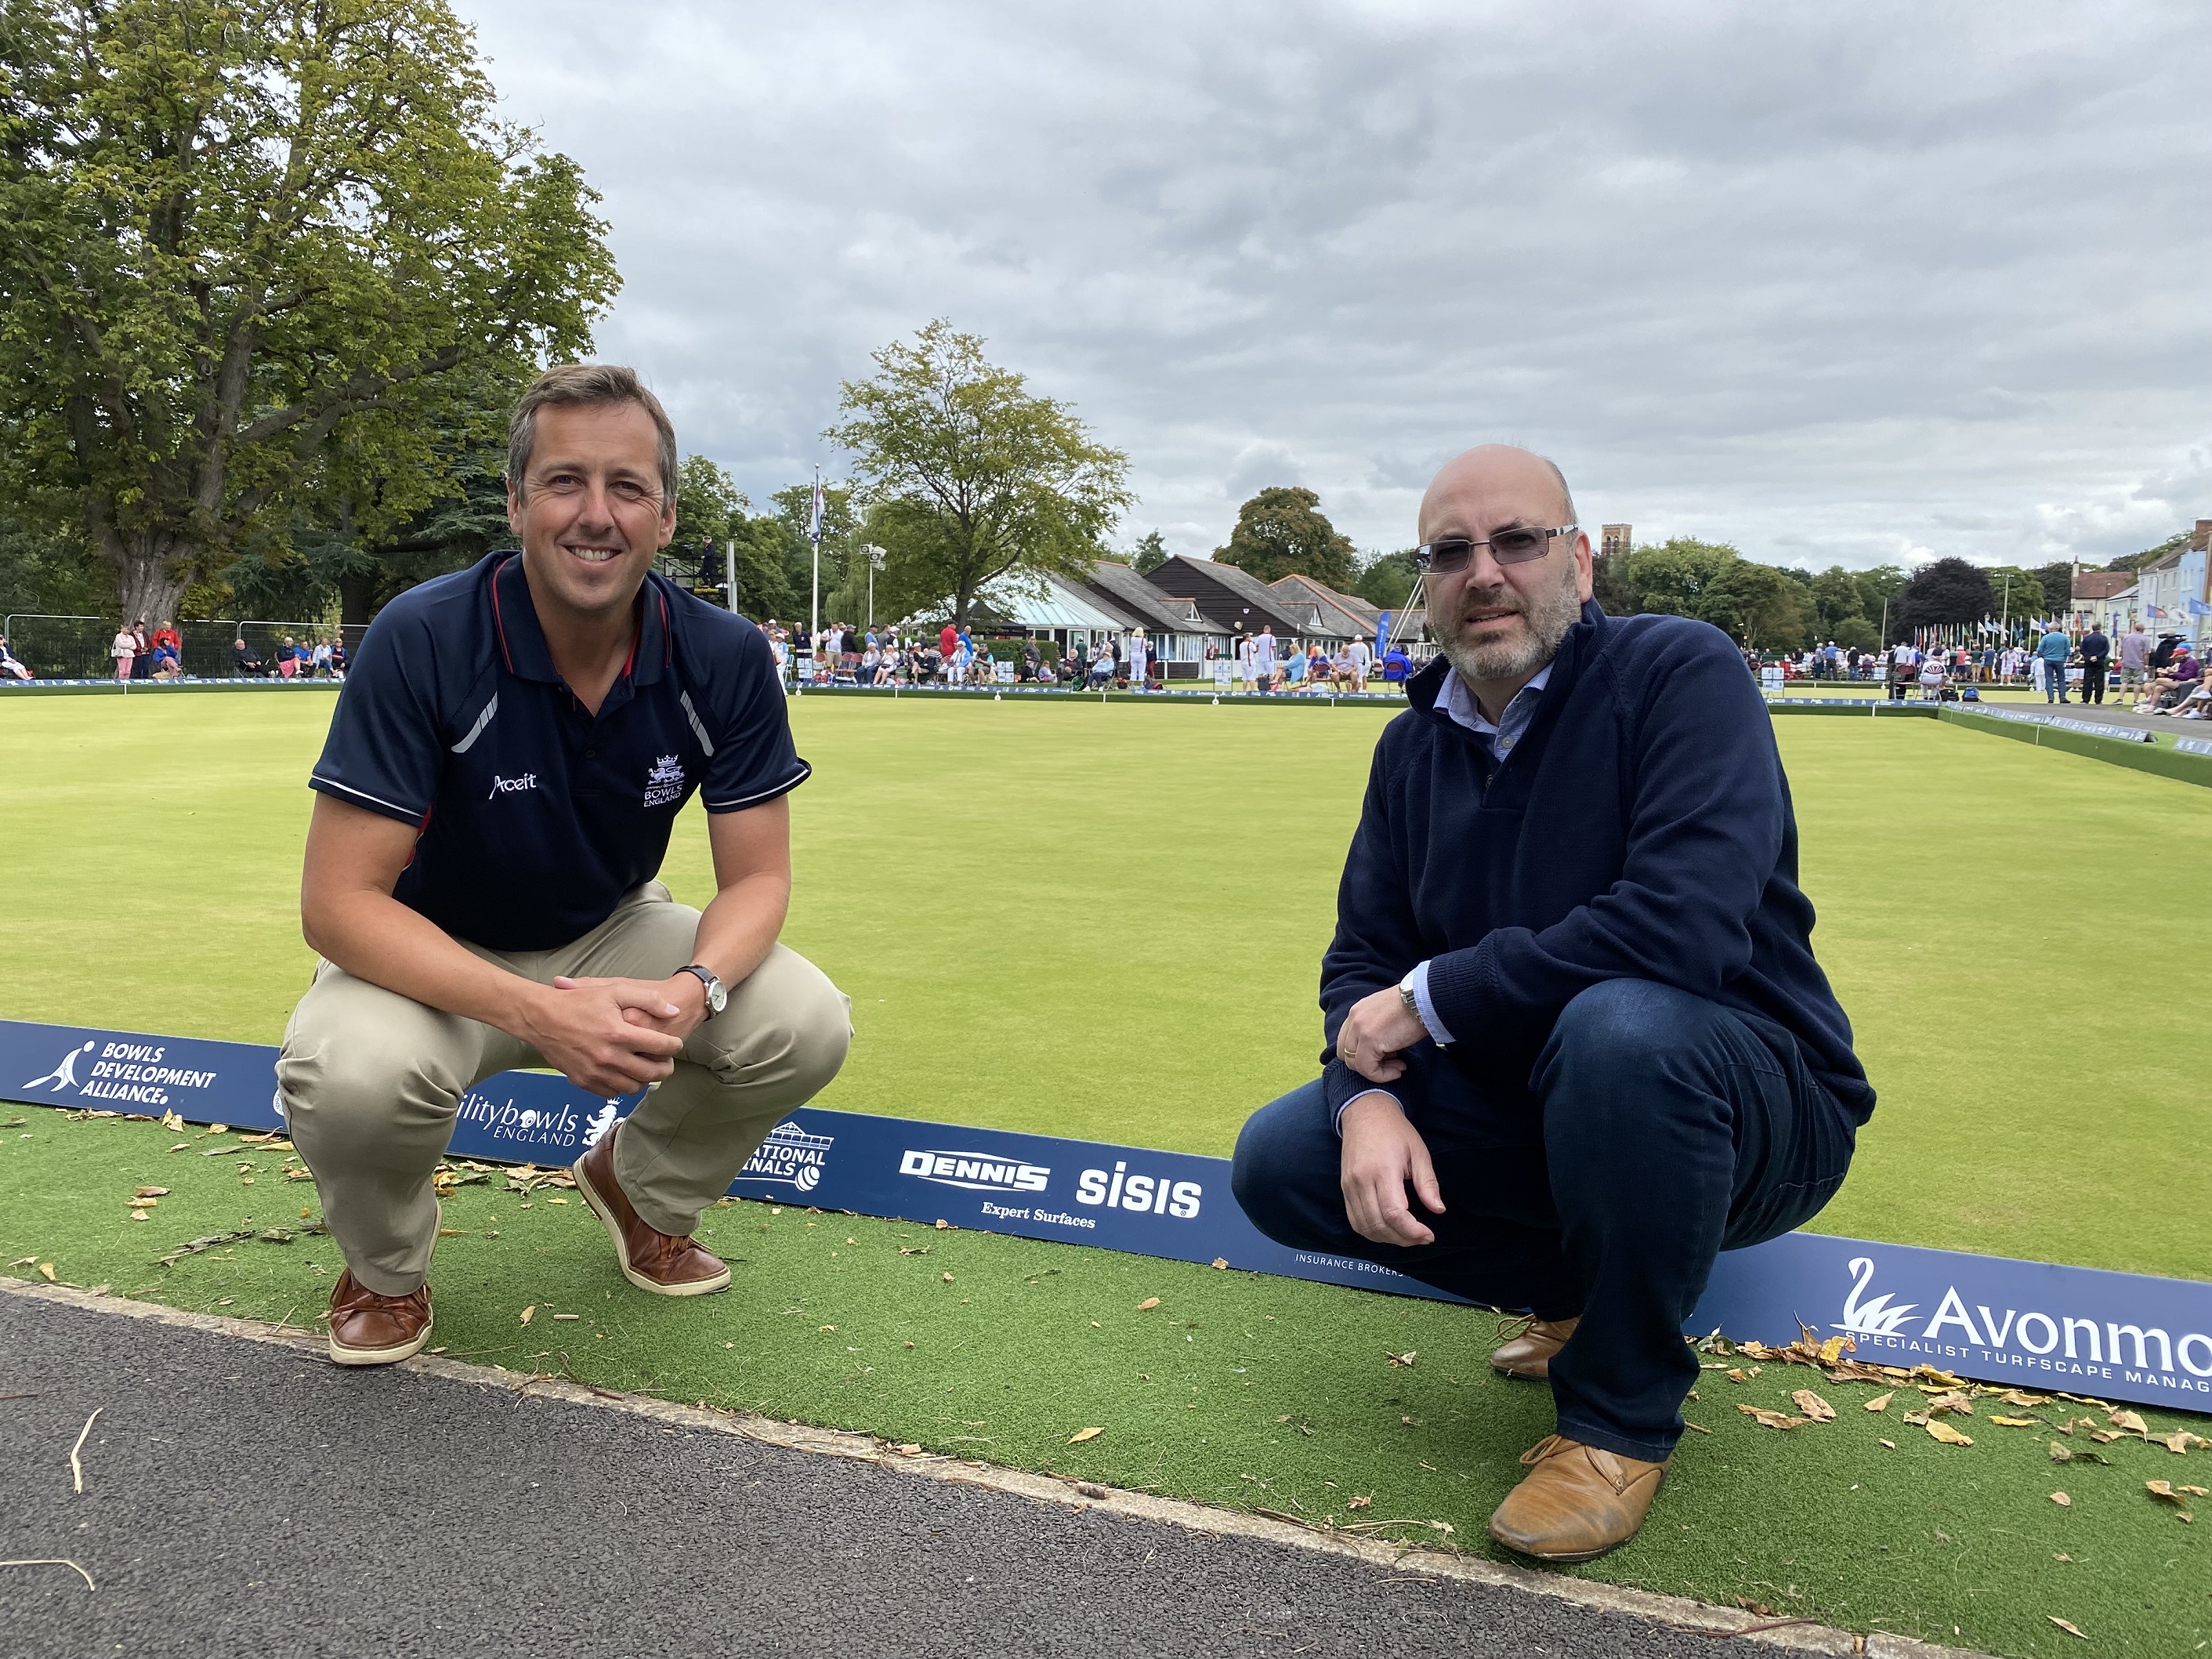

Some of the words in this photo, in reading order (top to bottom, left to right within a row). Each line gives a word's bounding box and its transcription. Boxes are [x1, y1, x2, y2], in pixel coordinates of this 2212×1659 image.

[643, 792, 681, 807] ENGLAND
[644, 784, 683, 800] BOWLS
[101, 1041, 166, 1063] BOWLS
[90, 1060, 218, 1088] DEVELOPMENT
[493, 1125, 575, 1147] ENGLAND
[899, 1150, 1051, 1192] DENNIS
[980, 1201, 1030, 1219] Expert
[1033, 1208, 1096, 1229] Surfaces
[1295, 1253, 1354, 1270] INSURANCE
[1921, 1285, 2212, 1378] Avonmo
[1845, 1331, 1970, 1358] SPECIALIST
[1981, 1350, 2113, 1379] TURFSCAPE
[2125, 1371, 2210, 1393] MANAG
